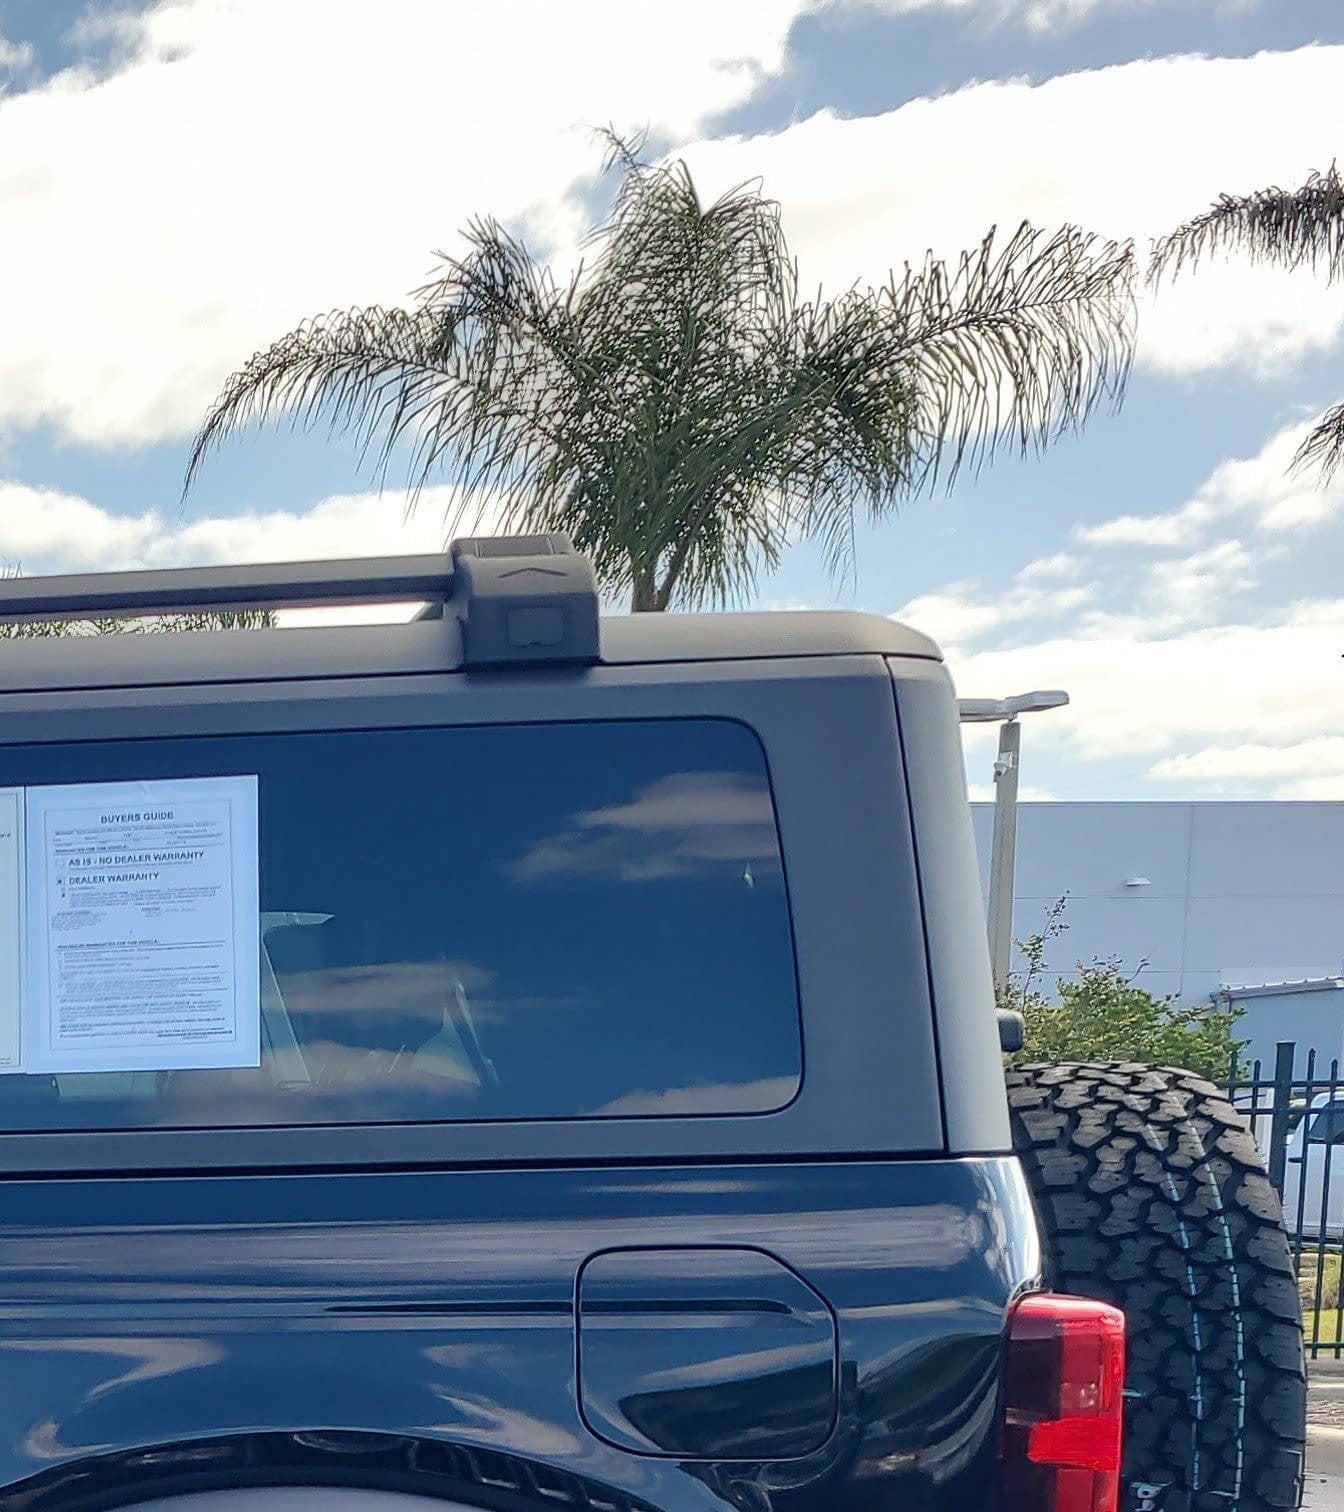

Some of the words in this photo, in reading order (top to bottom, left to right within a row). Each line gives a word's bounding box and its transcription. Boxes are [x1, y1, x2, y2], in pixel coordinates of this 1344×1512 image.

[100, 812, 141, 824] BUYERS
[143, 811, 174, 821] GUIDE
[69, 858, 81, 866] AS
[82, 857, 92, 866] IS
[98, 856, 112, 865] NO
[114, 853, 151, 865] DEALER
[153, 851, 205, 862] WARRANTY
[68, 874, 105, 886] DEALER
[106, 872, 160, 884] WARRANTY
